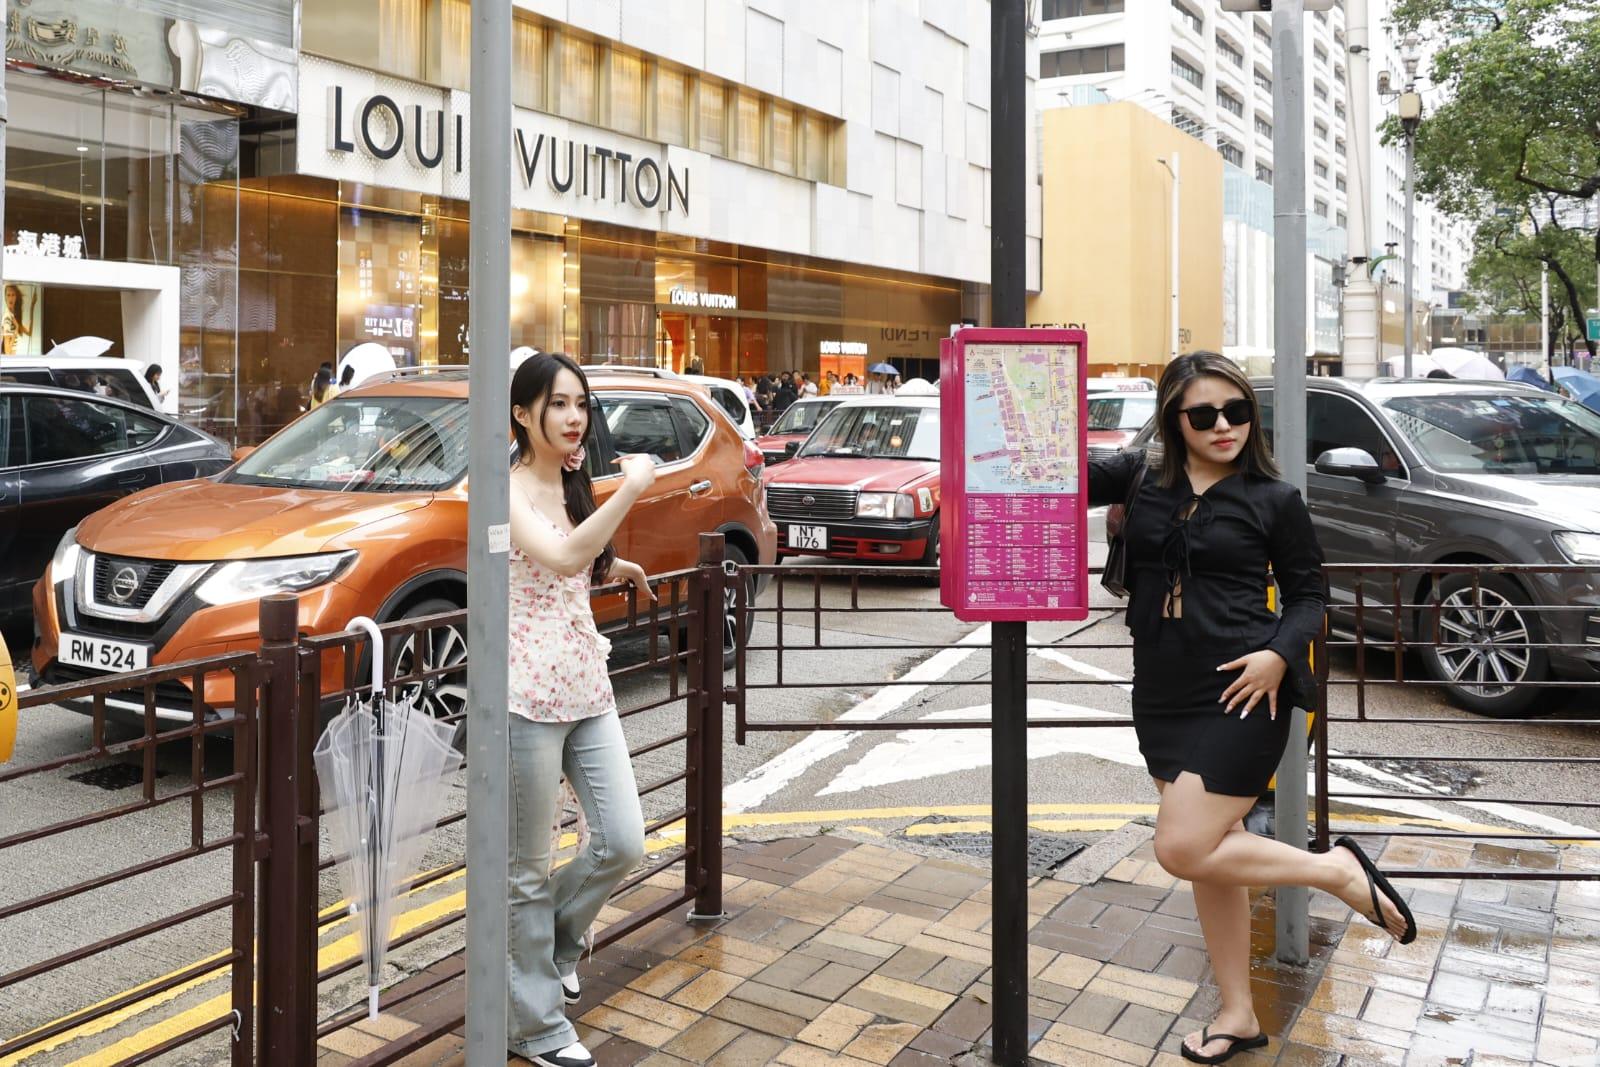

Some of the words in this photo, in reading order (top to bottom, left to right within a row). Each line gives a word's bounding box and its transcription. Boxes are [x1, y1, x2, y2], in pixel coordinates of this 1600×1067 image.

[330, 85, 463, 173] LOUI
[513, 127, 690, 217] VUITTON
[671, 288, 698, 306] LOUIS
[699, 292, 737, 309] VUITTON
[799, 525, 816, 537] NT
[796, 535, 819, 549] 1176
[71, 639, 94, 663] RM
[100, 644, 135, 670] 524
